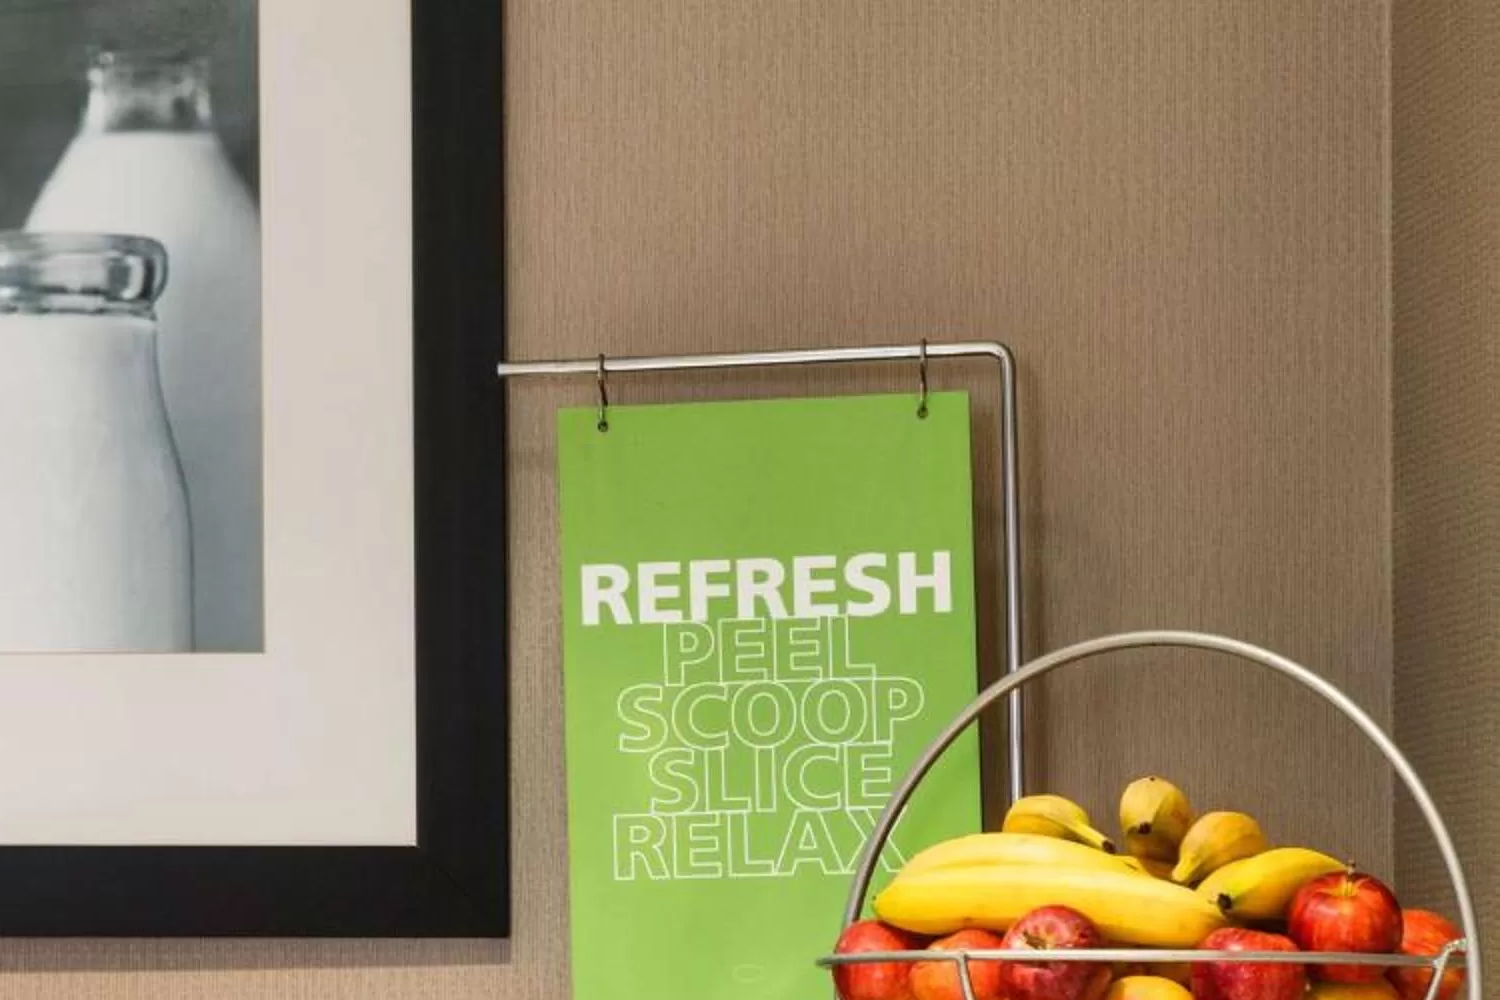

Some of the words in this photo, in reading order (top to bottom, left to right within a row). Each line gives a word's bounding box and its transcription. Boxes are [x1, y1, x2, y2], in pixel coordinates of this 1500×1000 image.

[581, 551, 953, 625] REFRESH
[663, 614, 876, 687] PEEL
[617, 677, 925, 752] SCOOP
[648, 743, 894, 816] SLICE
[613, 808, 906, 880] RELAX
